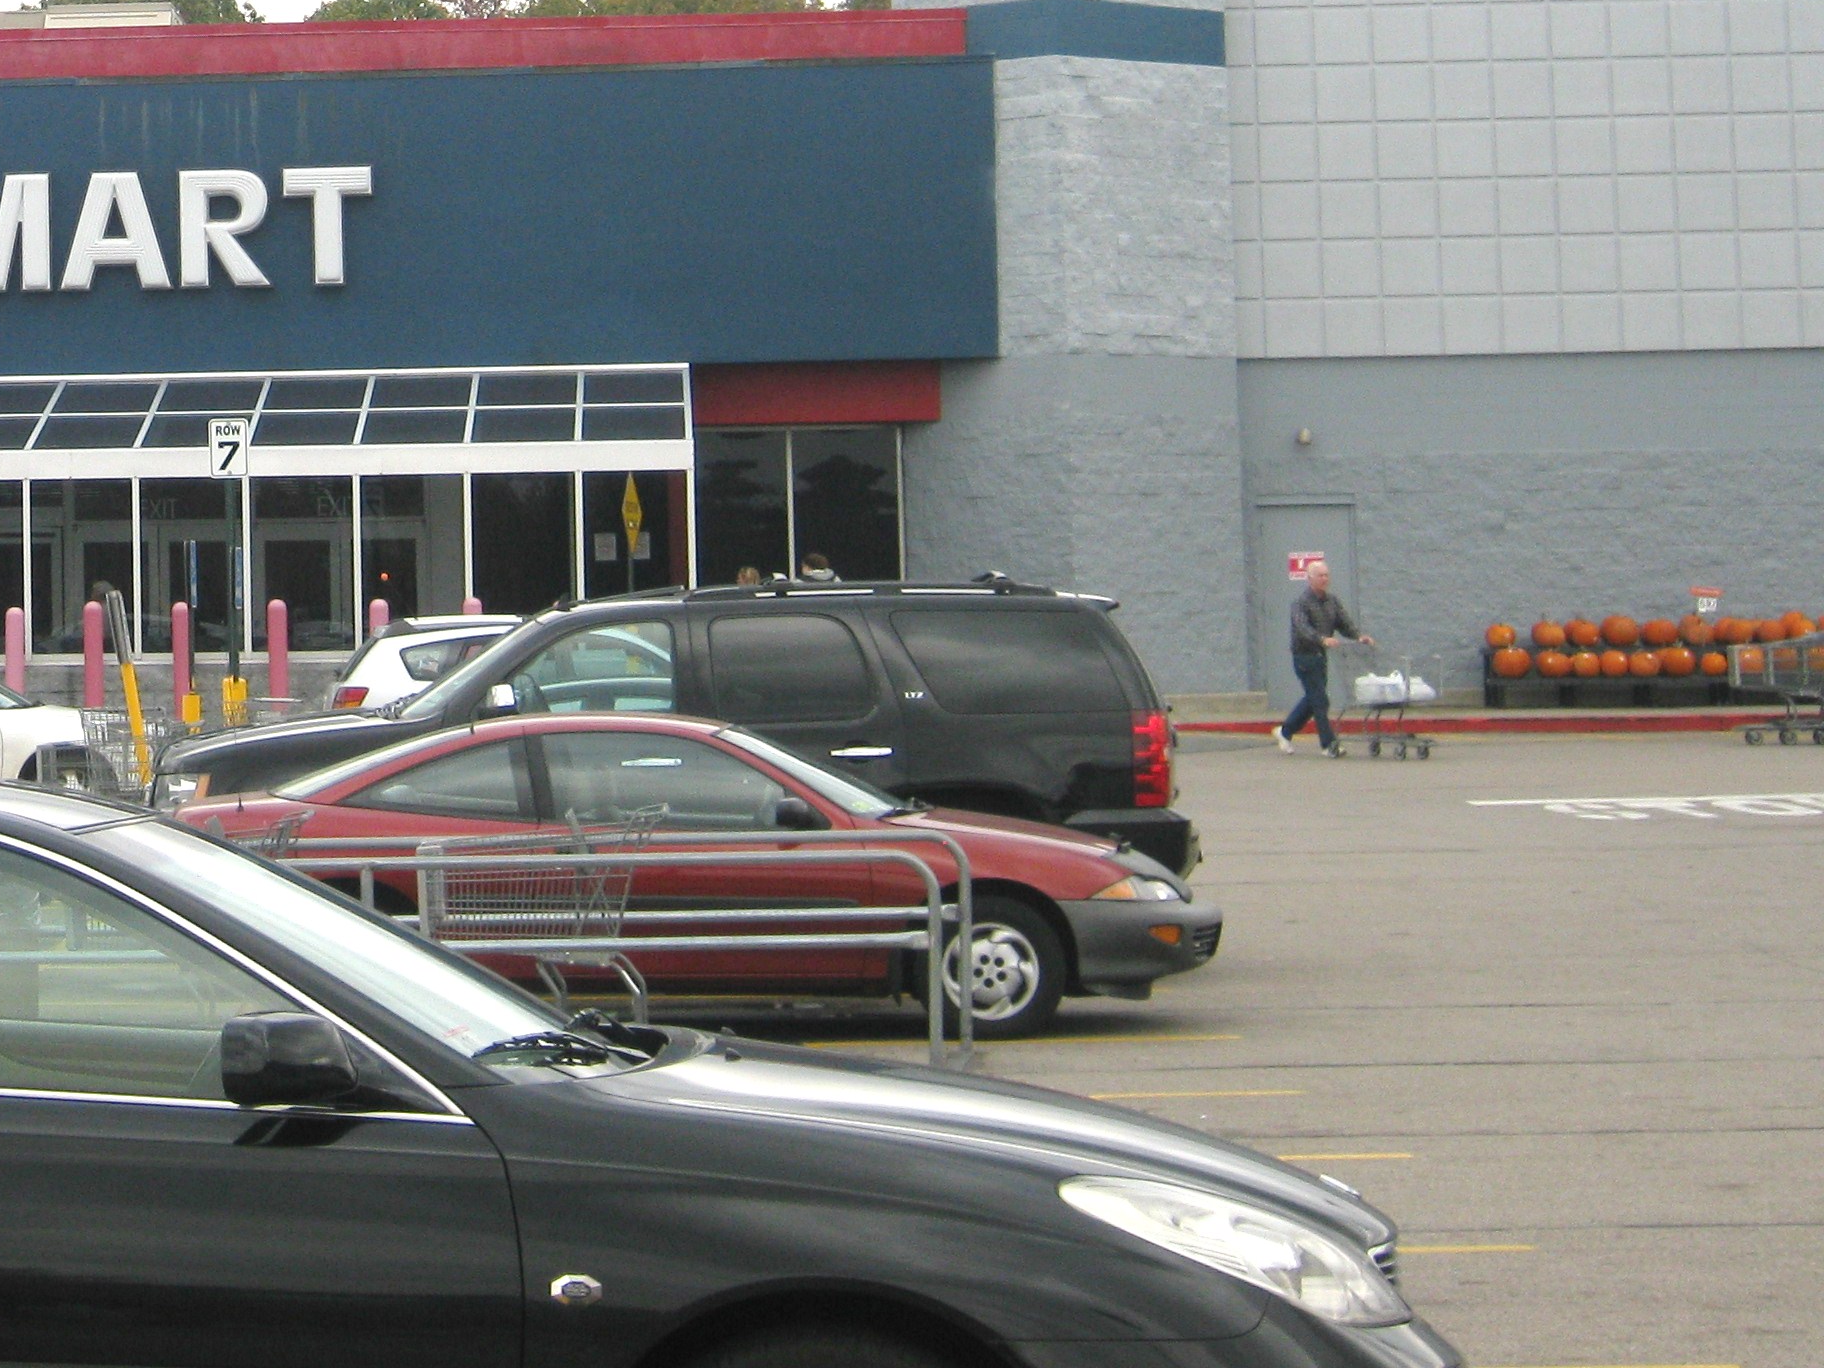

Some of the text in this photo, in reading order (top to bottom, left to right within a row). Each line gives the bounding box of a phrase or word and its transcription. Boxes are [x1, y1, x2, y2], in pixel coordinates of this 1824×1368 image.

[215, 425, 241, 436] ROW
[218, 441, 240, 470] 7
[317, 496, 352, 517] EXI
